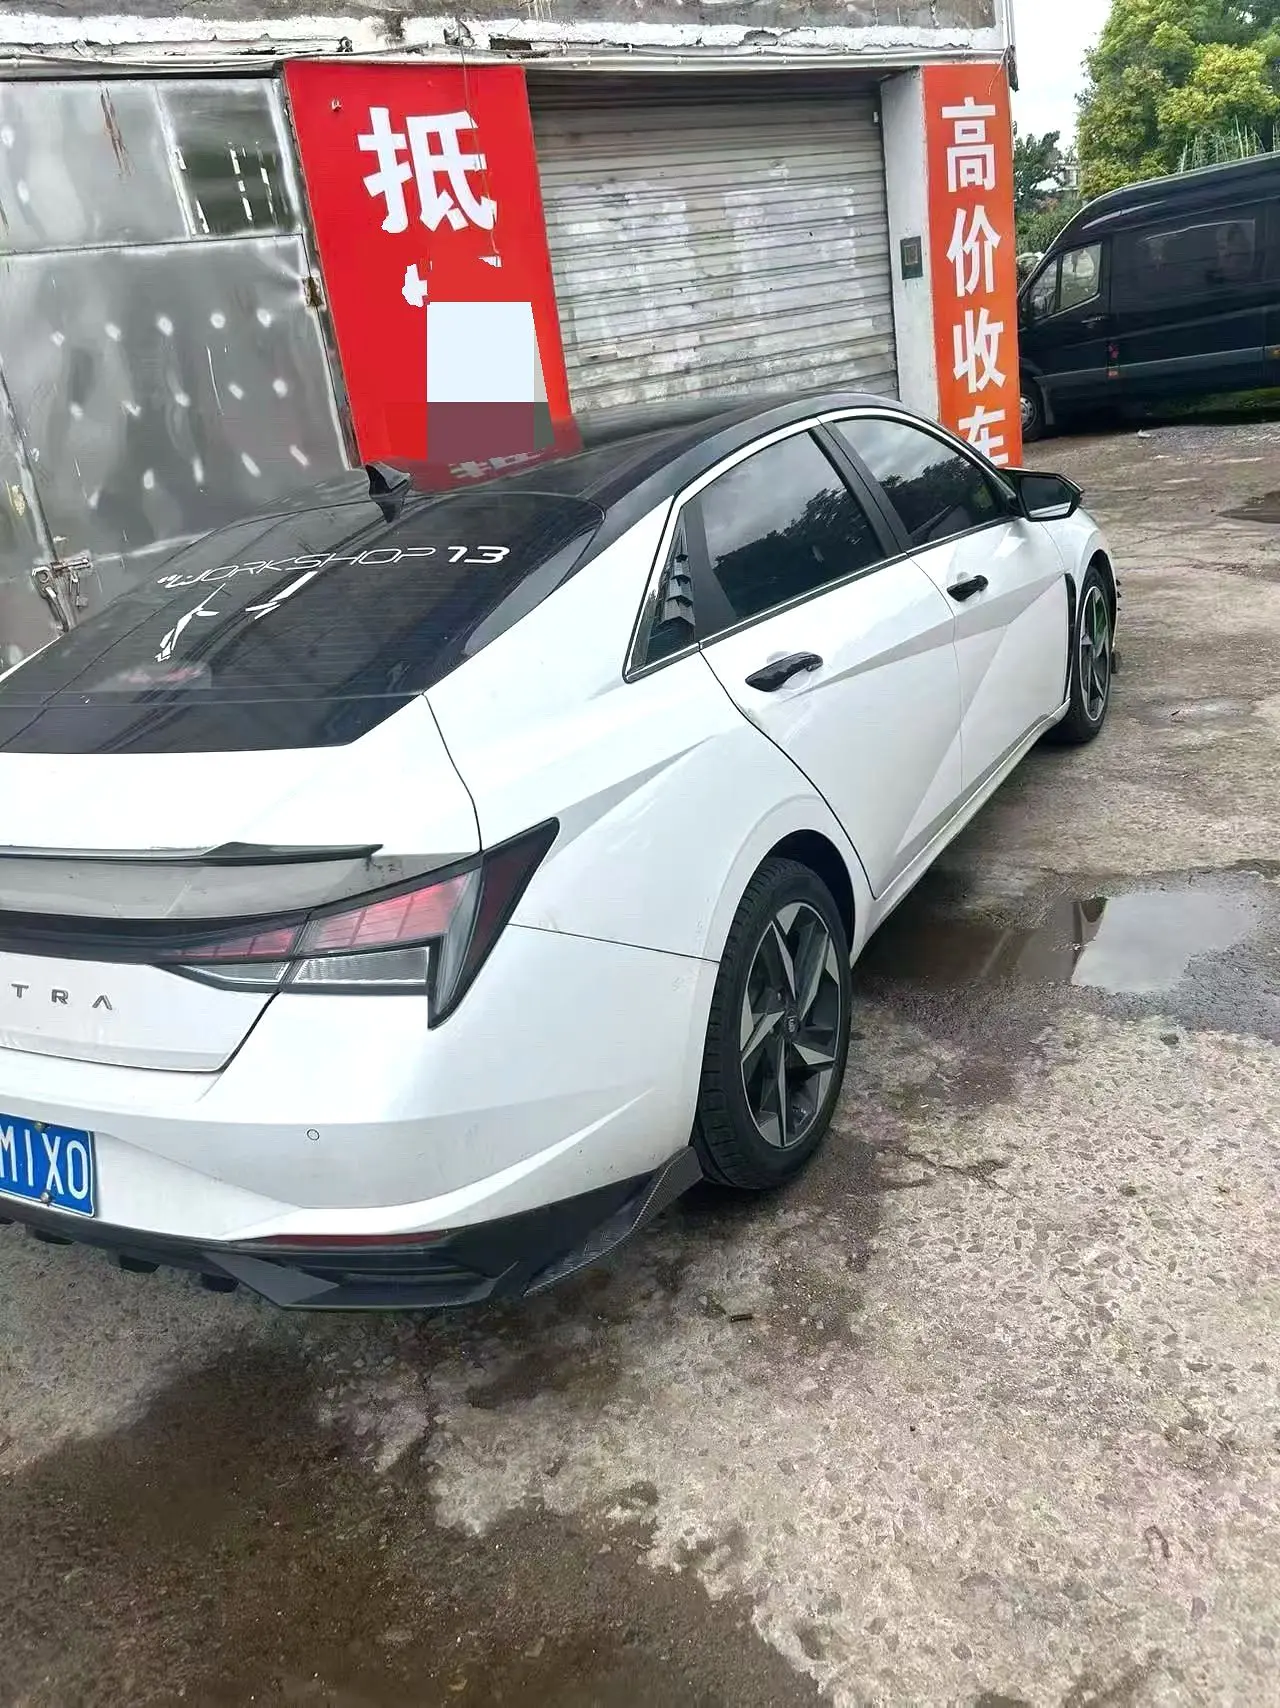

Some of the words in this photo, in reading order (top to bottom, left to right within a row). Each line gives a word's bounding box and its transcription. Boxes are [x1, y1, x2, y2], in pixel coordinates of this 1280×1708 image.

[357, 106, 498, 234] 抵
[941, 96, 1009, 468] 高价收车
[157, 547, 437, 589] WORKSHOP
[448, 545, 511, 565] 13
